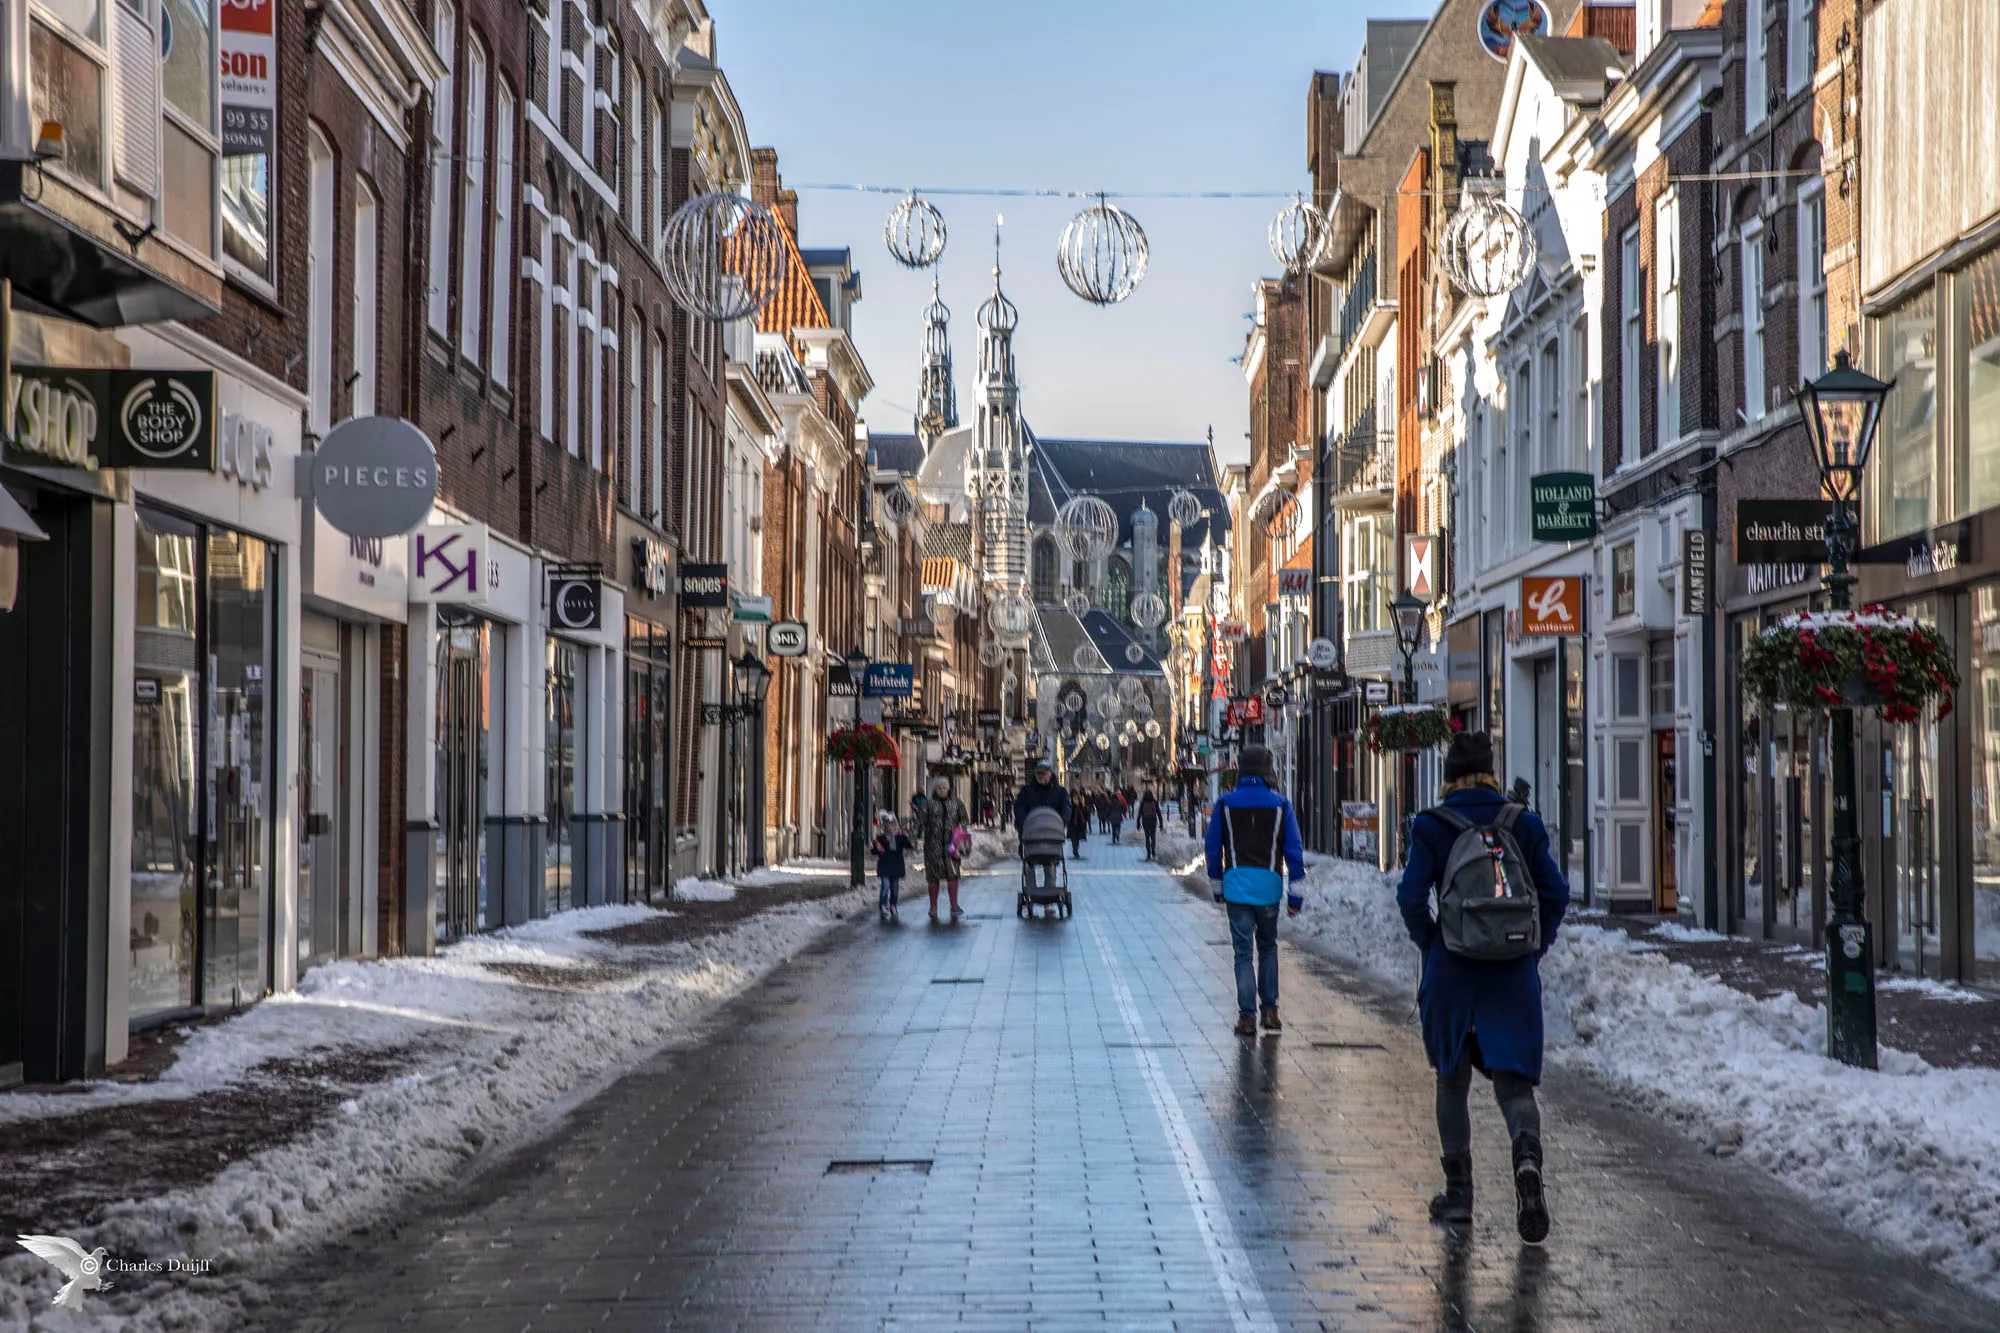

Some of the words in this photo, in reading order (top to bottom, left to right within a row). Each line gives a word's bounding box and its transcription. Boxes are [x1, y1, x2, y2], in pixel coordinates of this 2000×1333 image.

[226, 109, 245, 128] 99
[250, 111, 268, 131] 55
[148, 403, 175, 415] THE
[138, 416, 186, 430] BODY
[140, 430, 183, 443] SHOP
[325, 465, 427, 488] PIECES
[1535, 486, 1592, 503] HOLLAND
[1558, 501, 1569, 514] &
[1536, 512, 1592, 529] BARRETT
[1746, 521, 1801, 541] claudia
[1690, 532, 1705, 613] MANFIELD
[684, 577, 722, 595] snipes
[1528, 622, 1575, 633] vanHaren
[771, 632, 802, 645] ONLY
[870, 674, 909, 688] Hofstede
